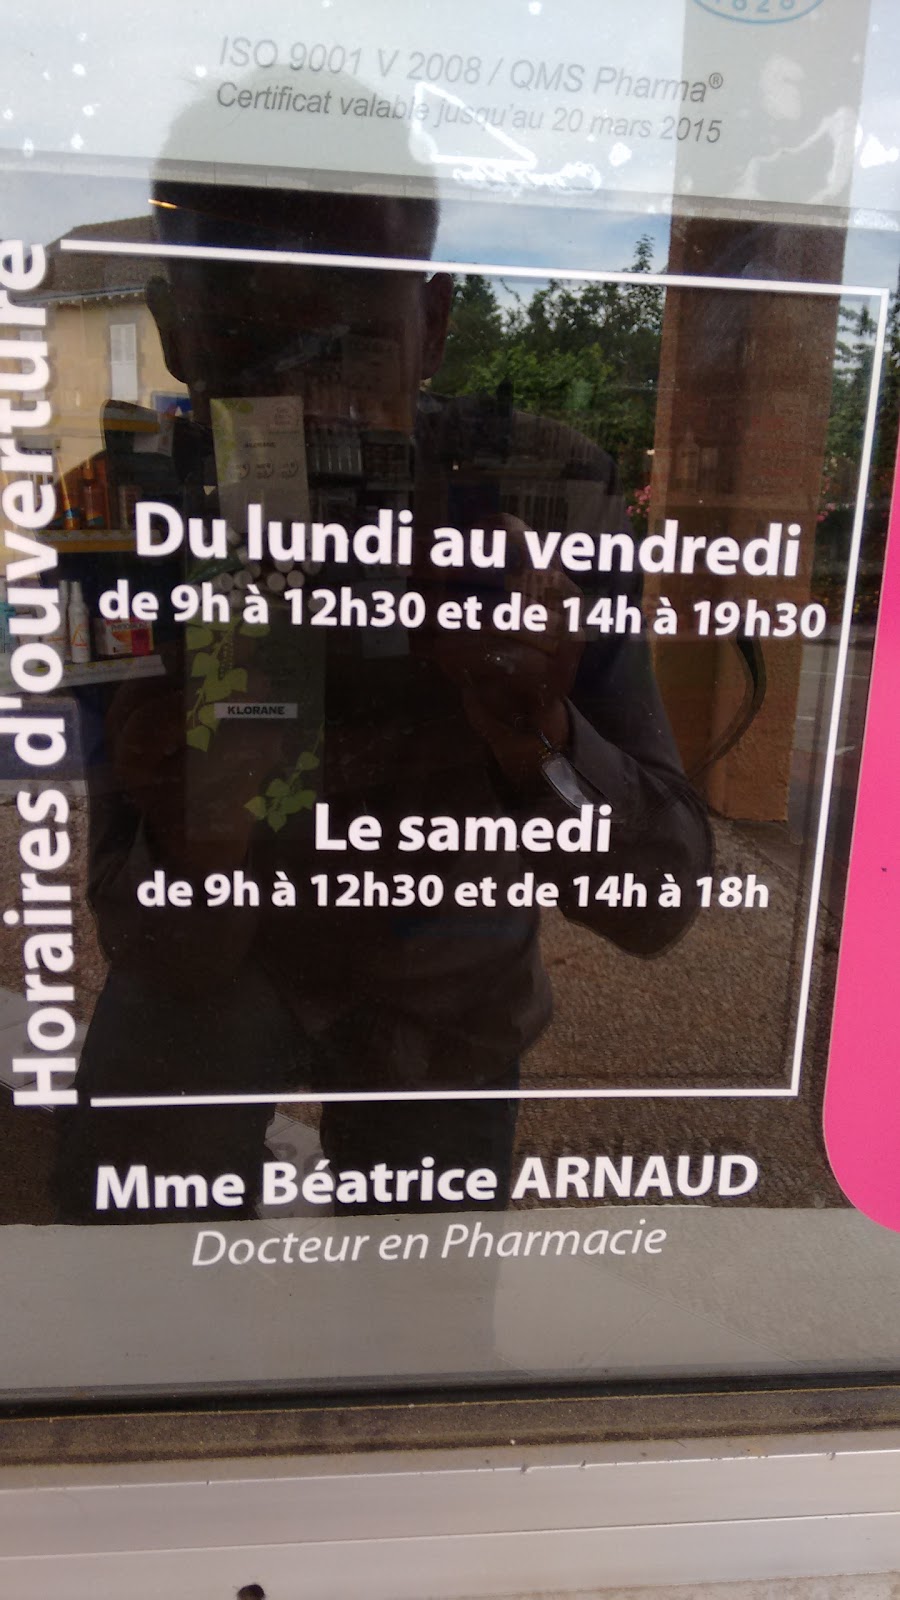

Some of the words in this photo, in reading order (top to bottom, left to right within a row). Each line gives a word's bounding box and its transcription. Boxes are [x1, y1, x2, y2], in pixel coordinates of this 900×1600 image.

[218, 36, 279, 69] ISO
[289, 42, 363, 76] 9001
[377, 50, 400, 78] V
[406, 52, 481, 85] 2008
[510, 59, 585, 94] QMS
[216, 81, 332, 115] Certificat
[339, 93, 430, 122] valable
[552, 107, 584, 134] 20
[589, 115, 654, 139] mars
[660, 115, 723, 144] 2015
[0, 240, 67, 766] d'ouverture
[135, 502, 227, 559] Du
[248, 504, 413, 565] lundi
[430, 527, 506, 568] au
[525, 519, 801, 577] vendredi
[98, 579, 159, 621] de
[171, 582, 230, 623] 9h
[243, 584, 270, 624] à
[284, 587, 426, 628] 12h30
[437, 596, 482, 630] et
[493, 592, 548, 632] de
[563, 595, 641, 634] 14h
[653, 596, 677, 635] à
[693, 599, 826, 638] 19h30
[227, 705, 285, 715] KLORANE
[315, 803, 382, 851] Le
[398, 804, 612, 852] samedi
[137, 870, 193, 907] de
[204, 870, 259, 906] 9h
[272, 871, 296, 906] à
[311, 871, 444, 907] 12h30
[454, 876, 497, 907] et
[507, 872, 559, 907] de
[573, 872, 647, 907] 14h
[658, 873, 681, 908] à
[696, 874, 769, 908] 18h
[3, 789, 78, 1107] Horaires
[95, 1165, 246, 1210] Mme
[263, 1156, 497, 1205] Béatrice
[511, 1154, 759, 1199] ARNAUD
[192, 1230, 370, 1267] Docteur
[378, 1233, 429, 1261] en
[441, 1218, 667, 1259] Pharmacie
